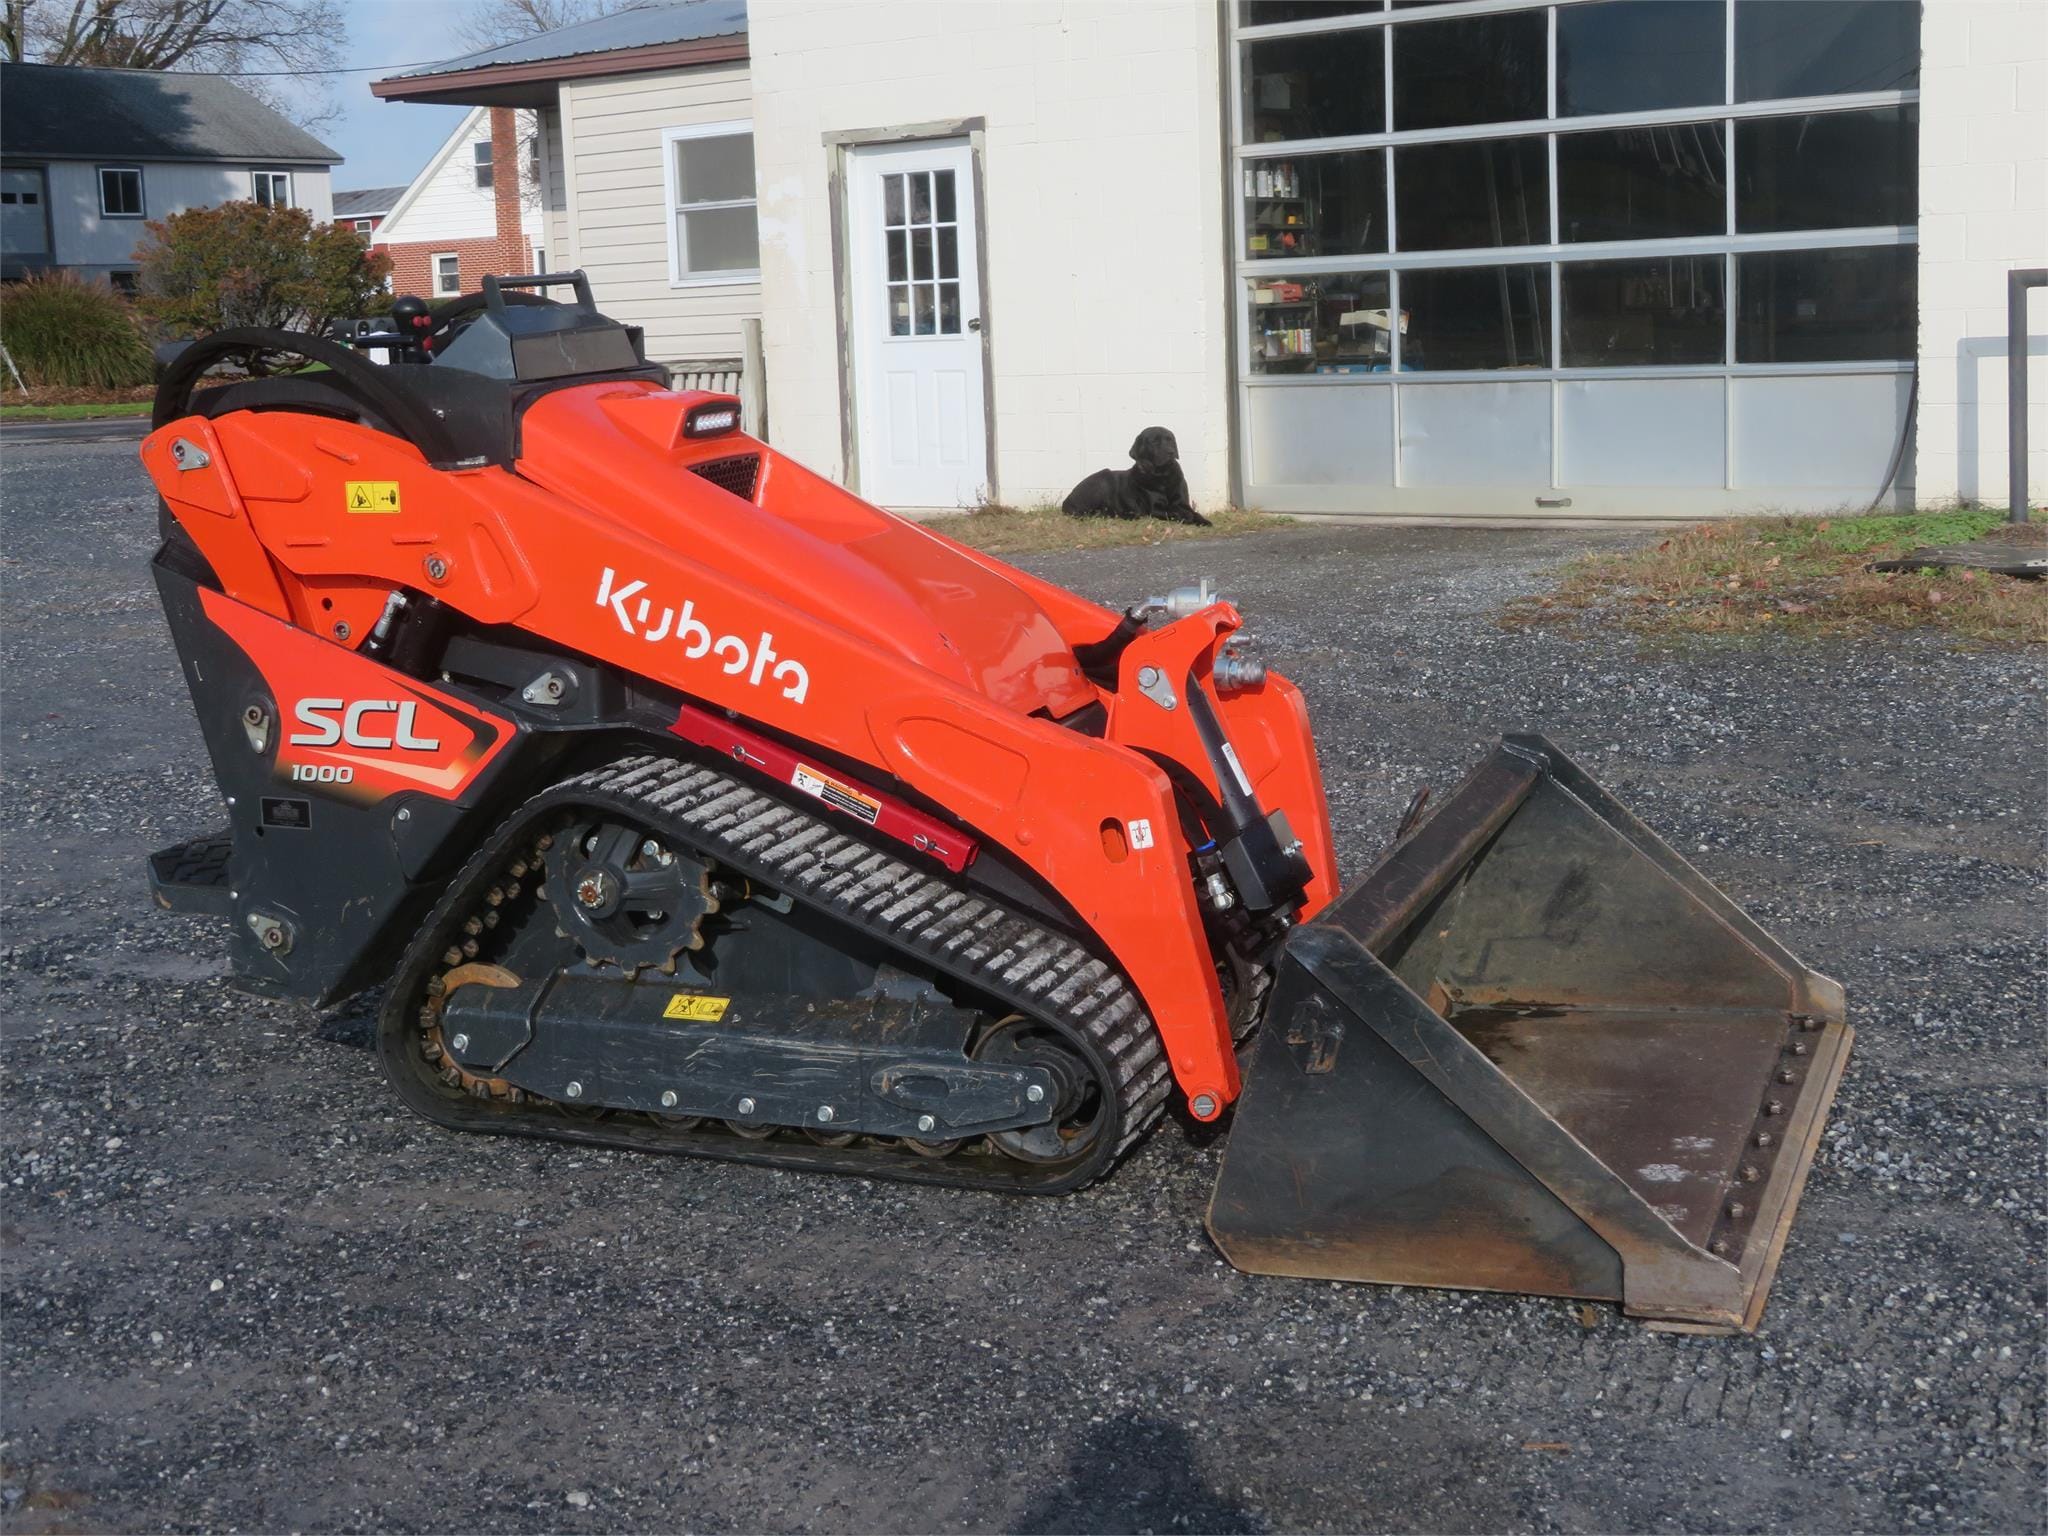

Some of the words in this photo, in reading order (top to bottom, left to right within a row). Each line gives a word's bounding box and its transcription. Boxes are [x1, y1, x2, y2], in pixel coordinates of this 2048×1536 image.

[596, 567, 809, 705] Kubota
[290, 698, 439, 751] SCL
[292, 765, 354, 783] 1000
